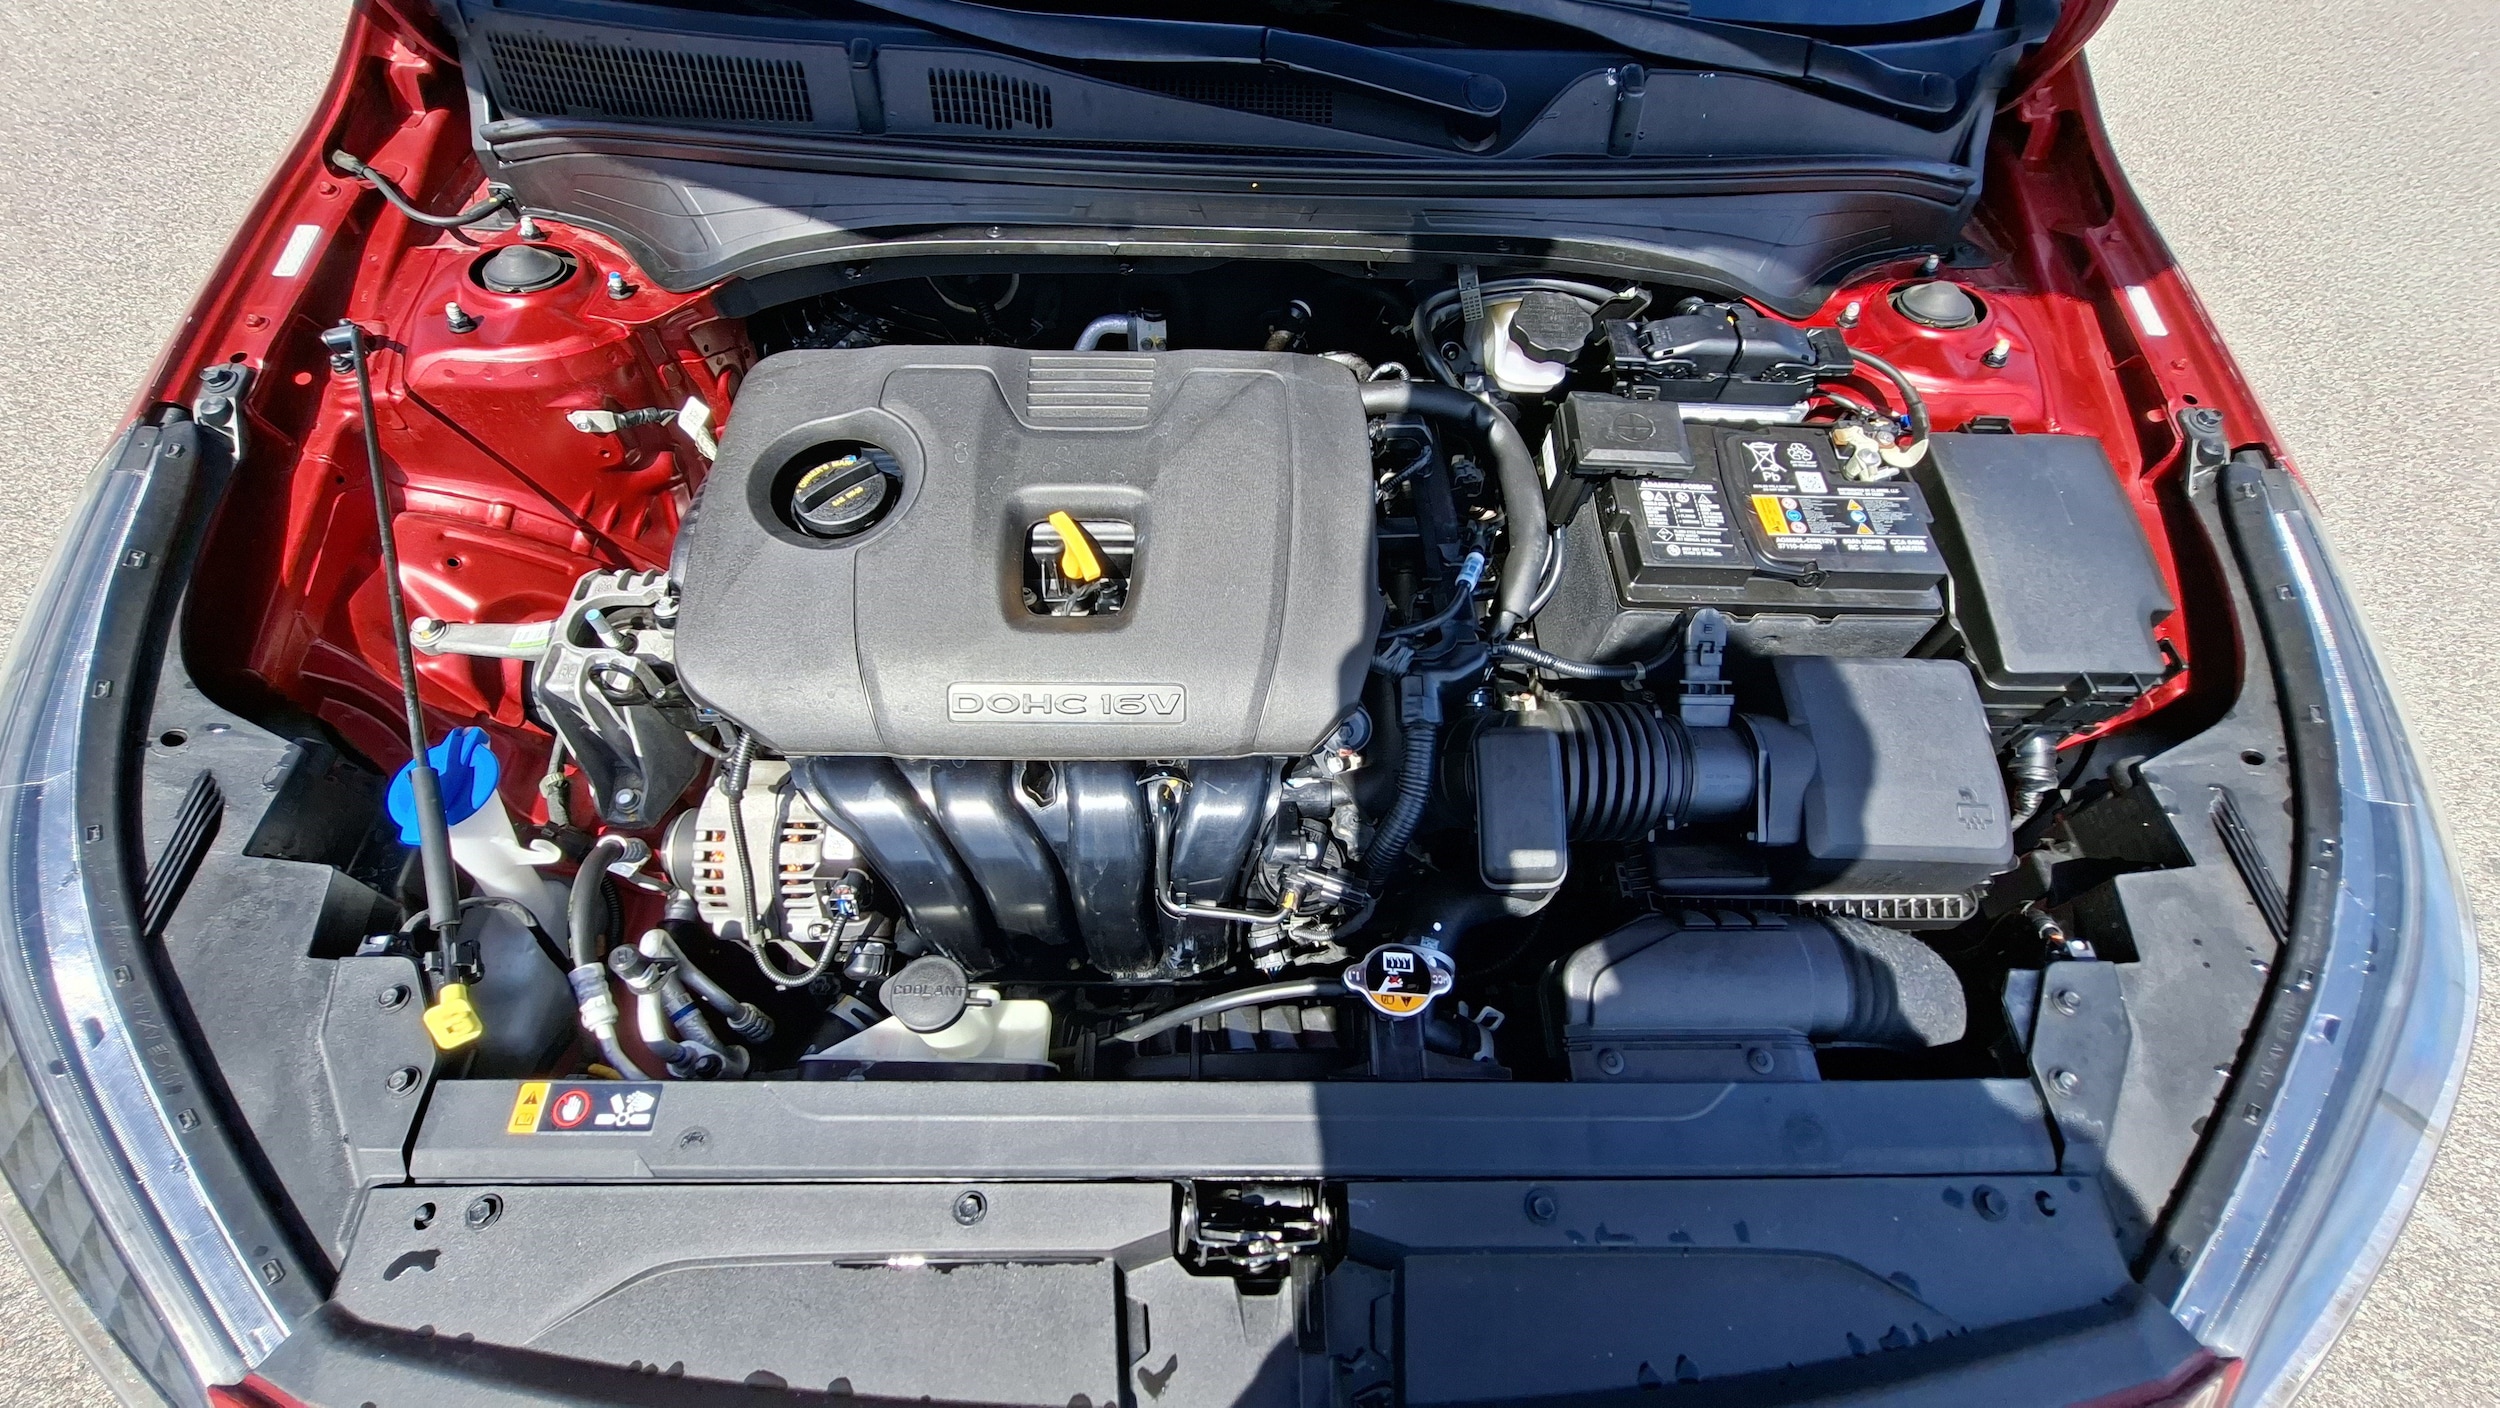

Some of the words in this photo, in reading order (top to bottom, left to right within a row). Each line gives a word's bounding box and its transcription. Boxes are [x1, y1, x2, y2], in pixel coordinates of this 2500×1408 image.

[1762, 471, 1781, 482] Pb
[832, 496, 846, 506] SAE
[951, 692, 1087, 715] DOHC
[1100, 693, 1182, 715] 16V
[1347, 970, 1361, 982] 1.1
[893, 984, 966, 998] COOLANT
